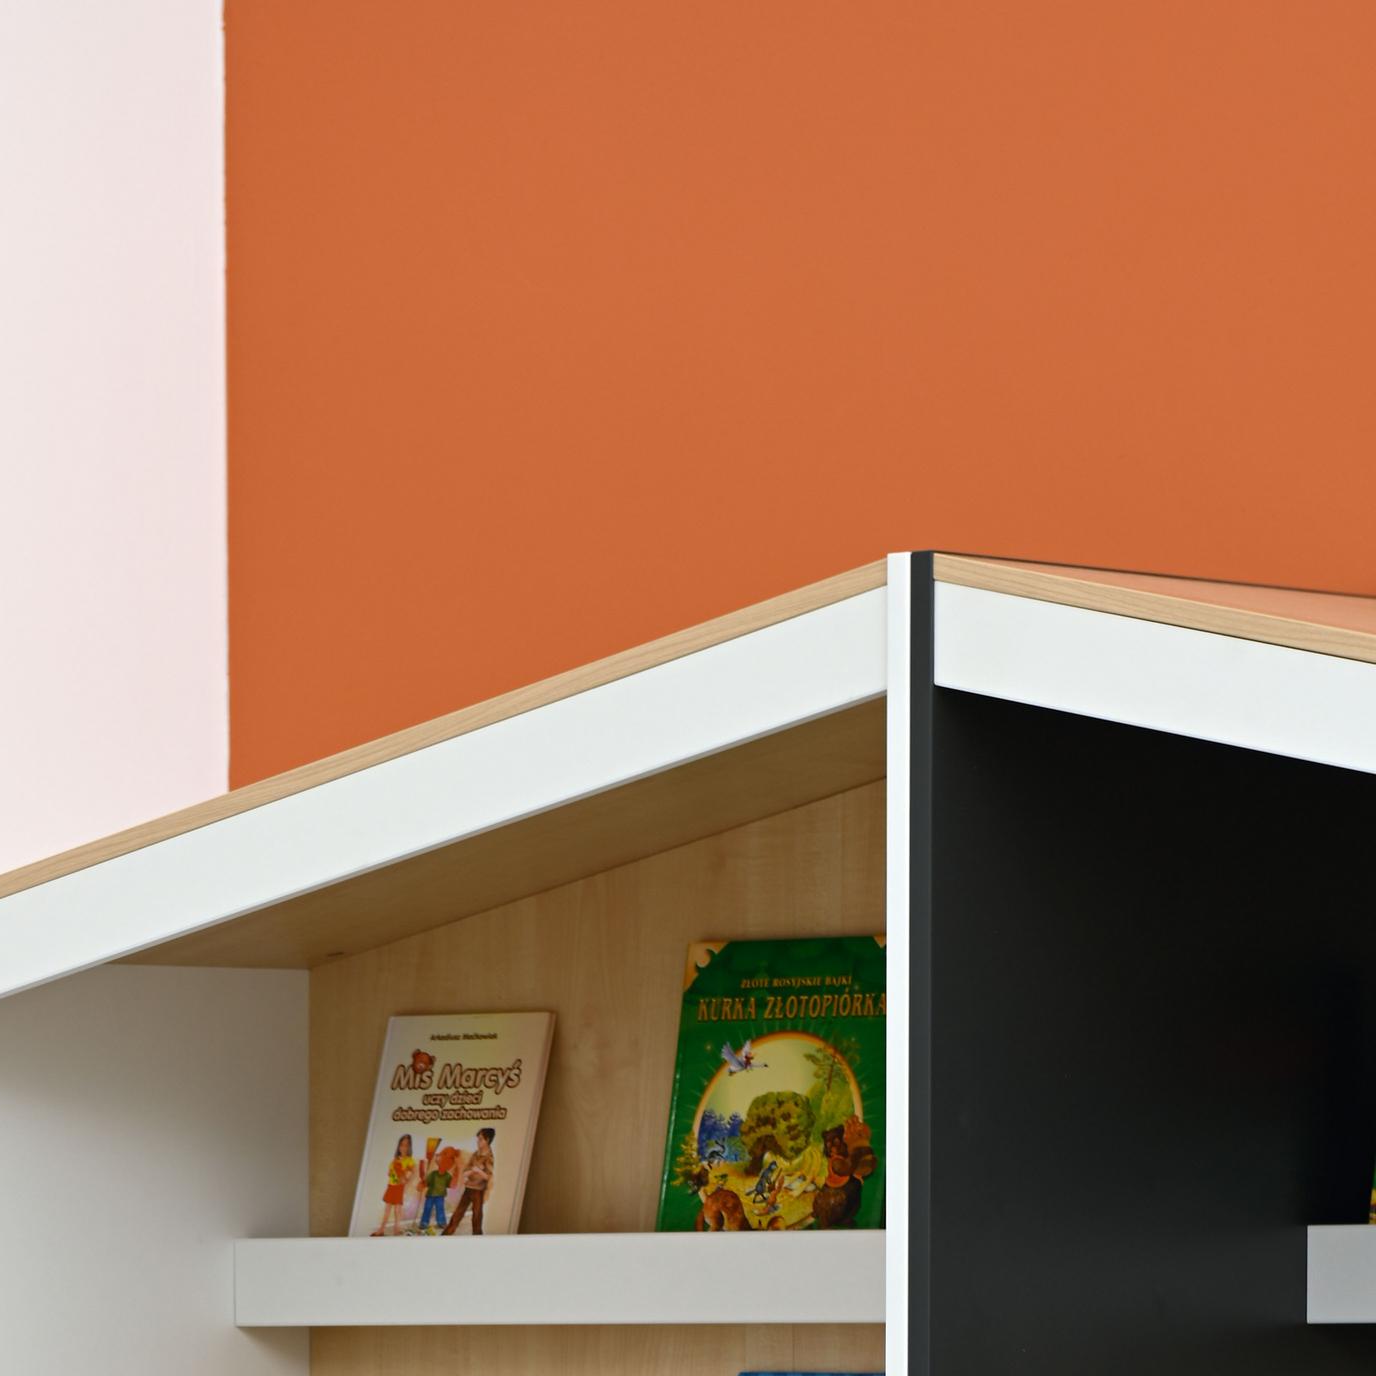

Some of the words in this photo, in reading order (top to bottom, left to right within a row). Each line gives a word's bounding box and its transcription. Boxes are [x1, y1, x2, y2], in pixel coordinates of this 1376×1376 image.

[697, 997, 757, 1022] KURKA
[763, 988, 886, 1020] ZŁOTOPIÓRKA
[437, 1058, 522, 1095] Marcyś
[392, 1106, 439, 1124] dobrego
